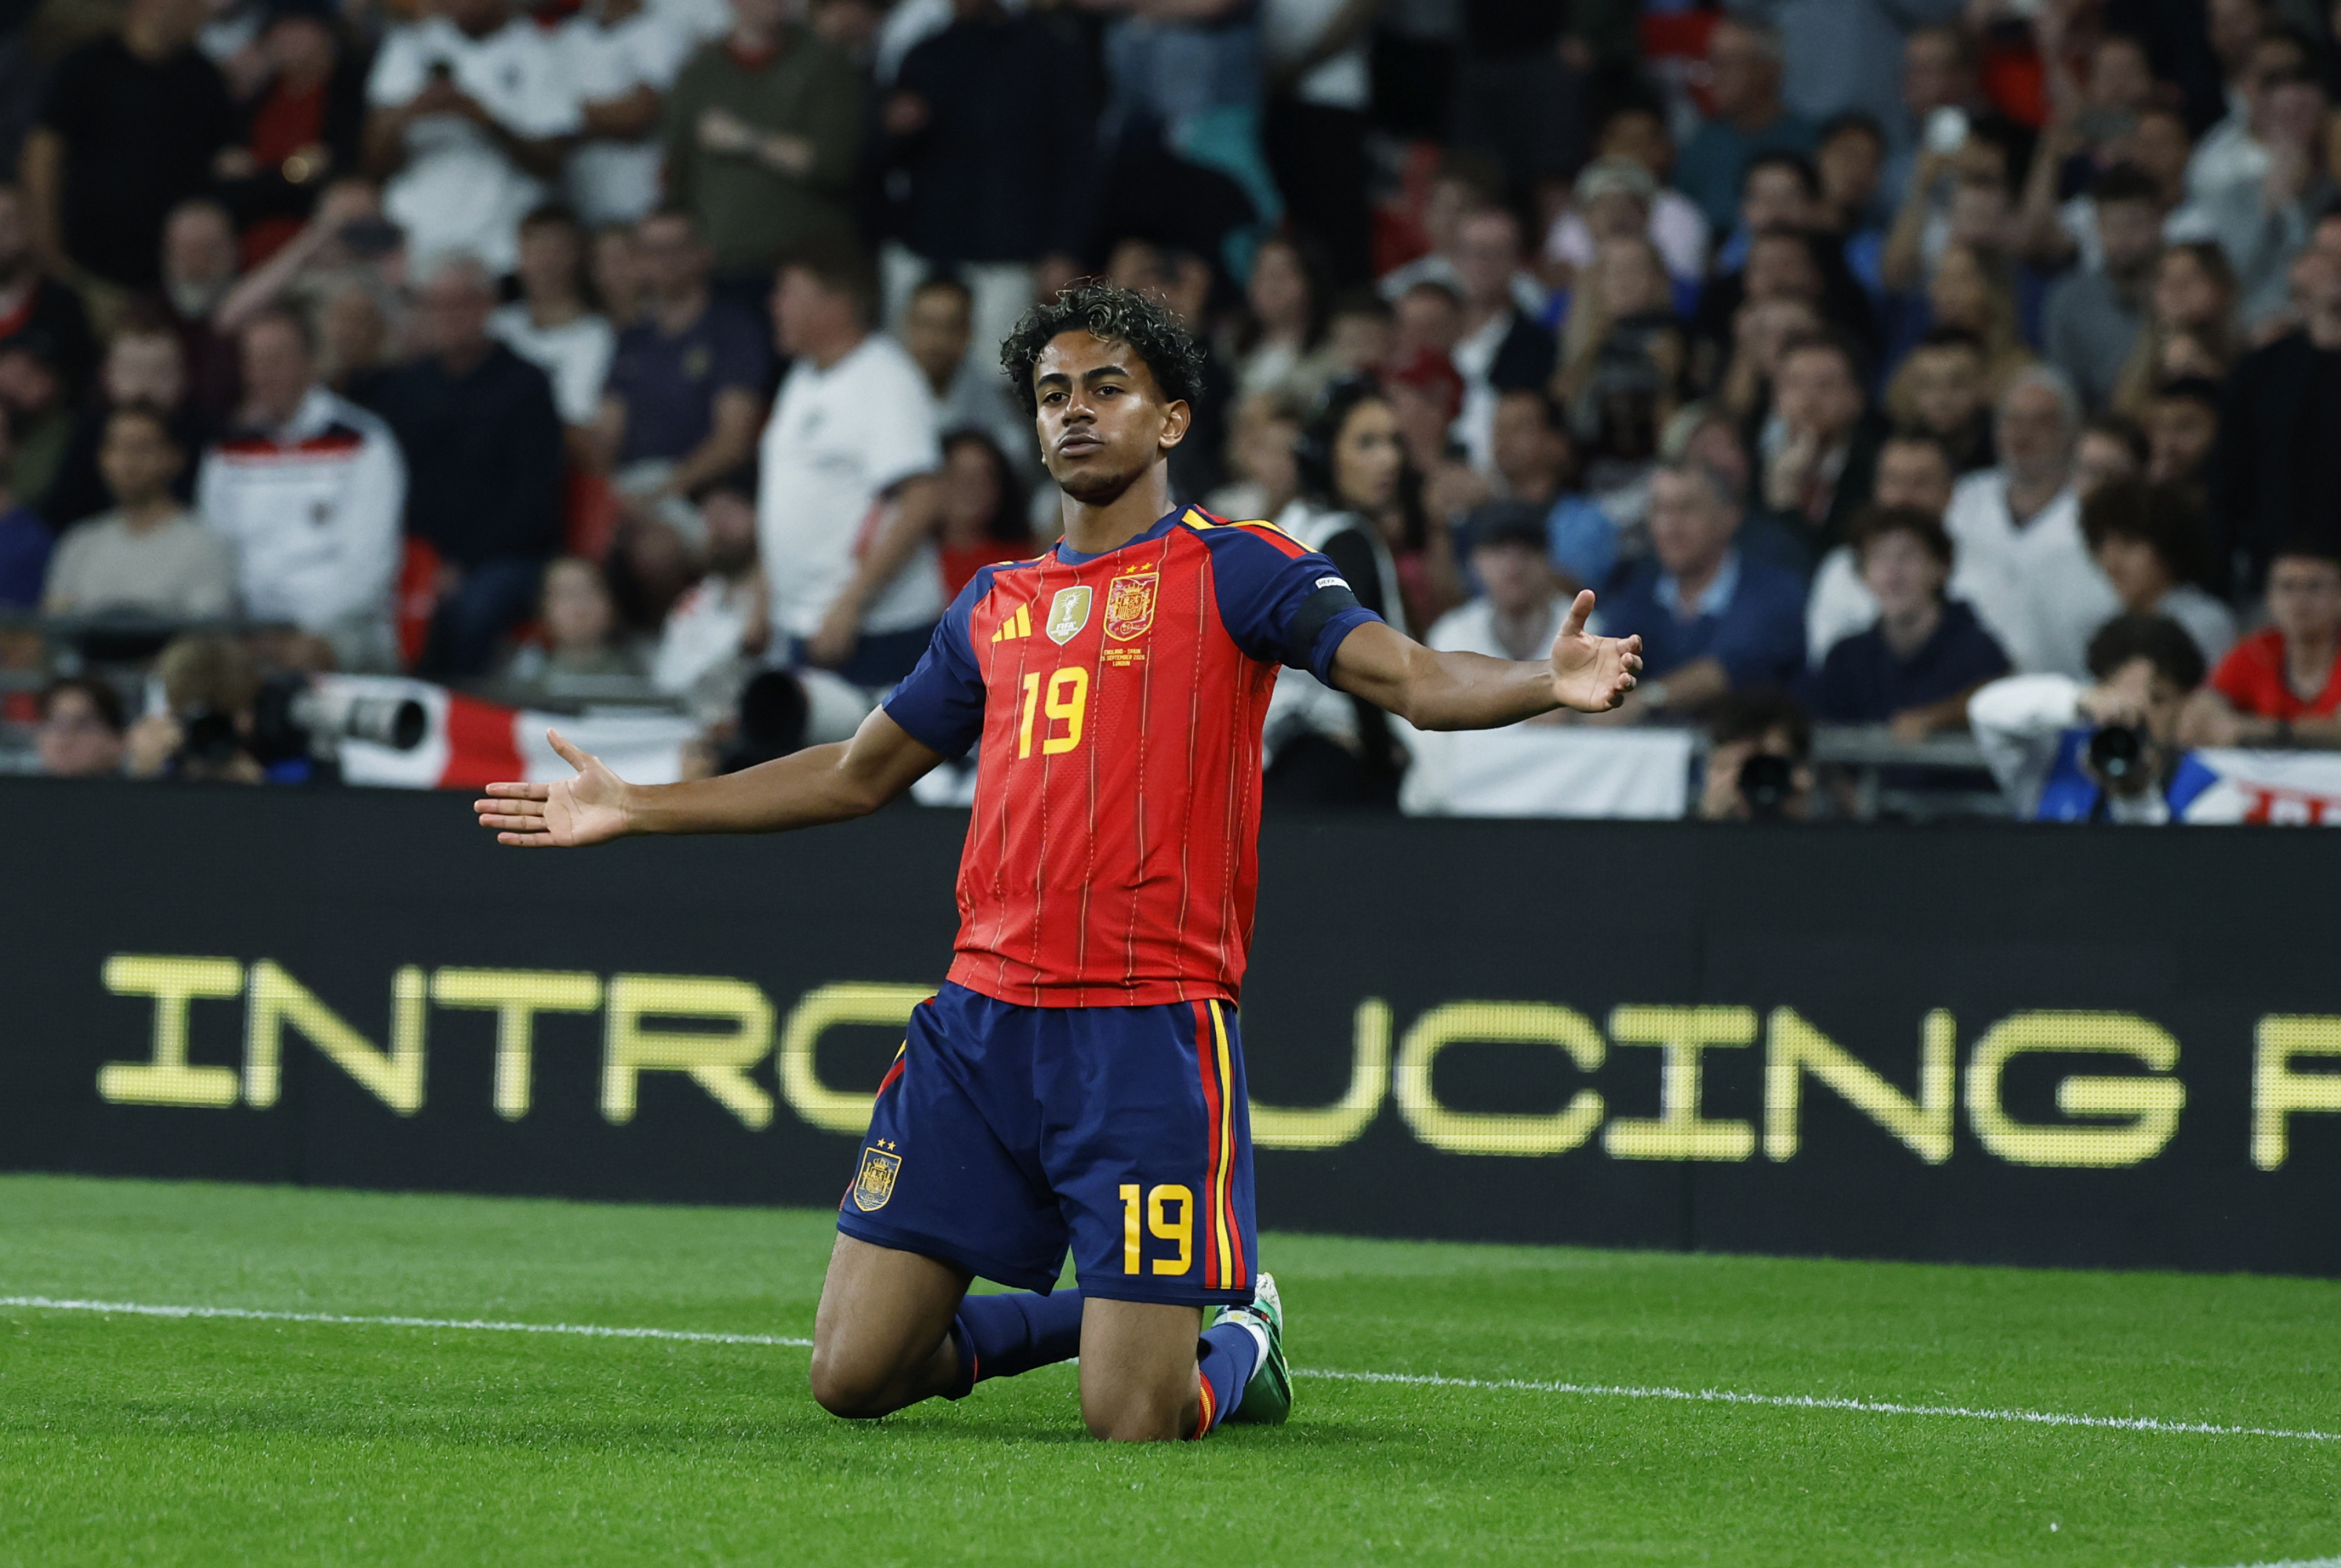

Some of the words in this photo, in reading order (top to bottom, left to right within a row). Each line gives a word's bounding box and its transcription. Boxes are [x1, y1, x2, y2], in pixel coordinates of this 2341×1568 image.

[1056, 621, 1074, 630] FIFA
[1018, 666, 1089, 760] 19
[97, 955, 2187, 1170] INTROUCING
[1120, 1184, 1193, 1276] 19
